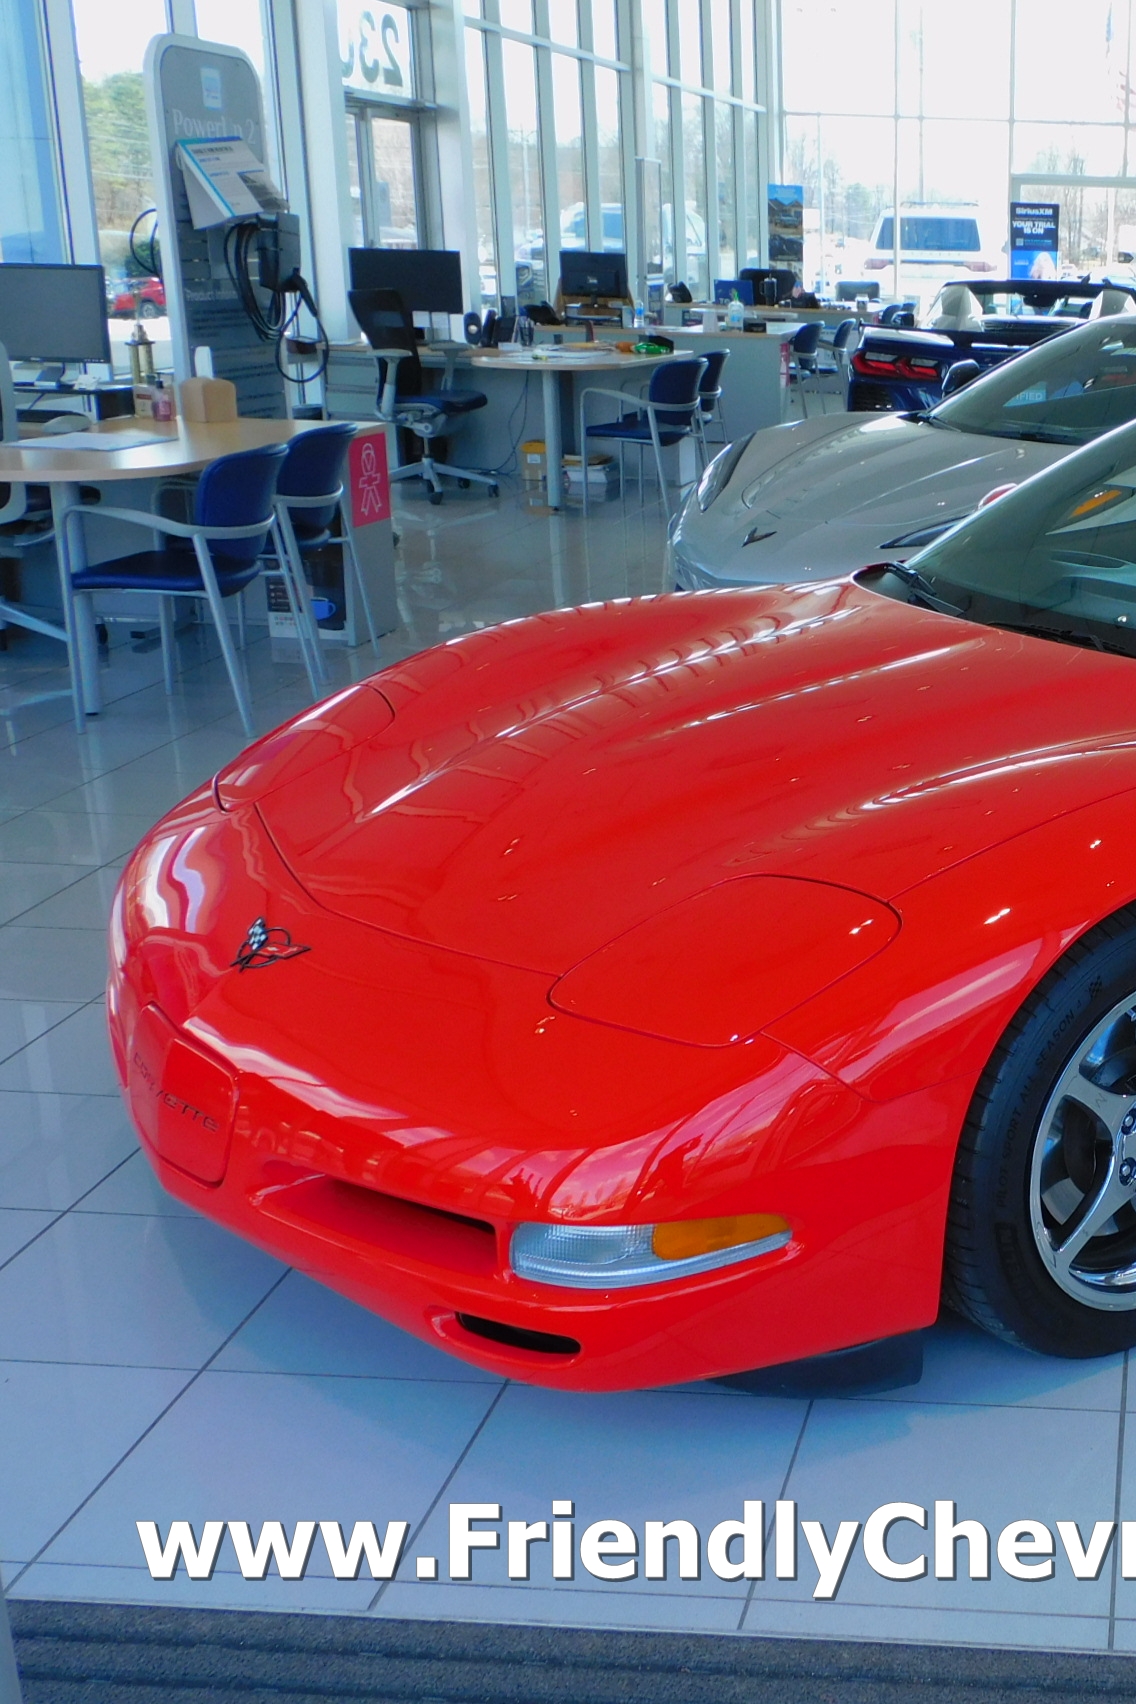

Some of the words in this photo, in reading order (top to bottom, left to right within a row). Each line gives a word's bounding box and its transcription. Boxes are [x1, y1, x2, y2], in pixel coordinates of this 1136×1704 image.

[1012, 220, 1033, 229] YOUR
[1034, 221, 1056, 229] TRIAL
[1015, 207, 1053, 216] SiriusXM
[1032, 227, 1044, 235] ON
[1034, 1009, 1076, 1067] SEASON
[1019, 1075, 1036, 1104] ALL
[1001, 1106, 1022, 1160] SPORT
[995, 1166, 1009, 1209] PILOT
